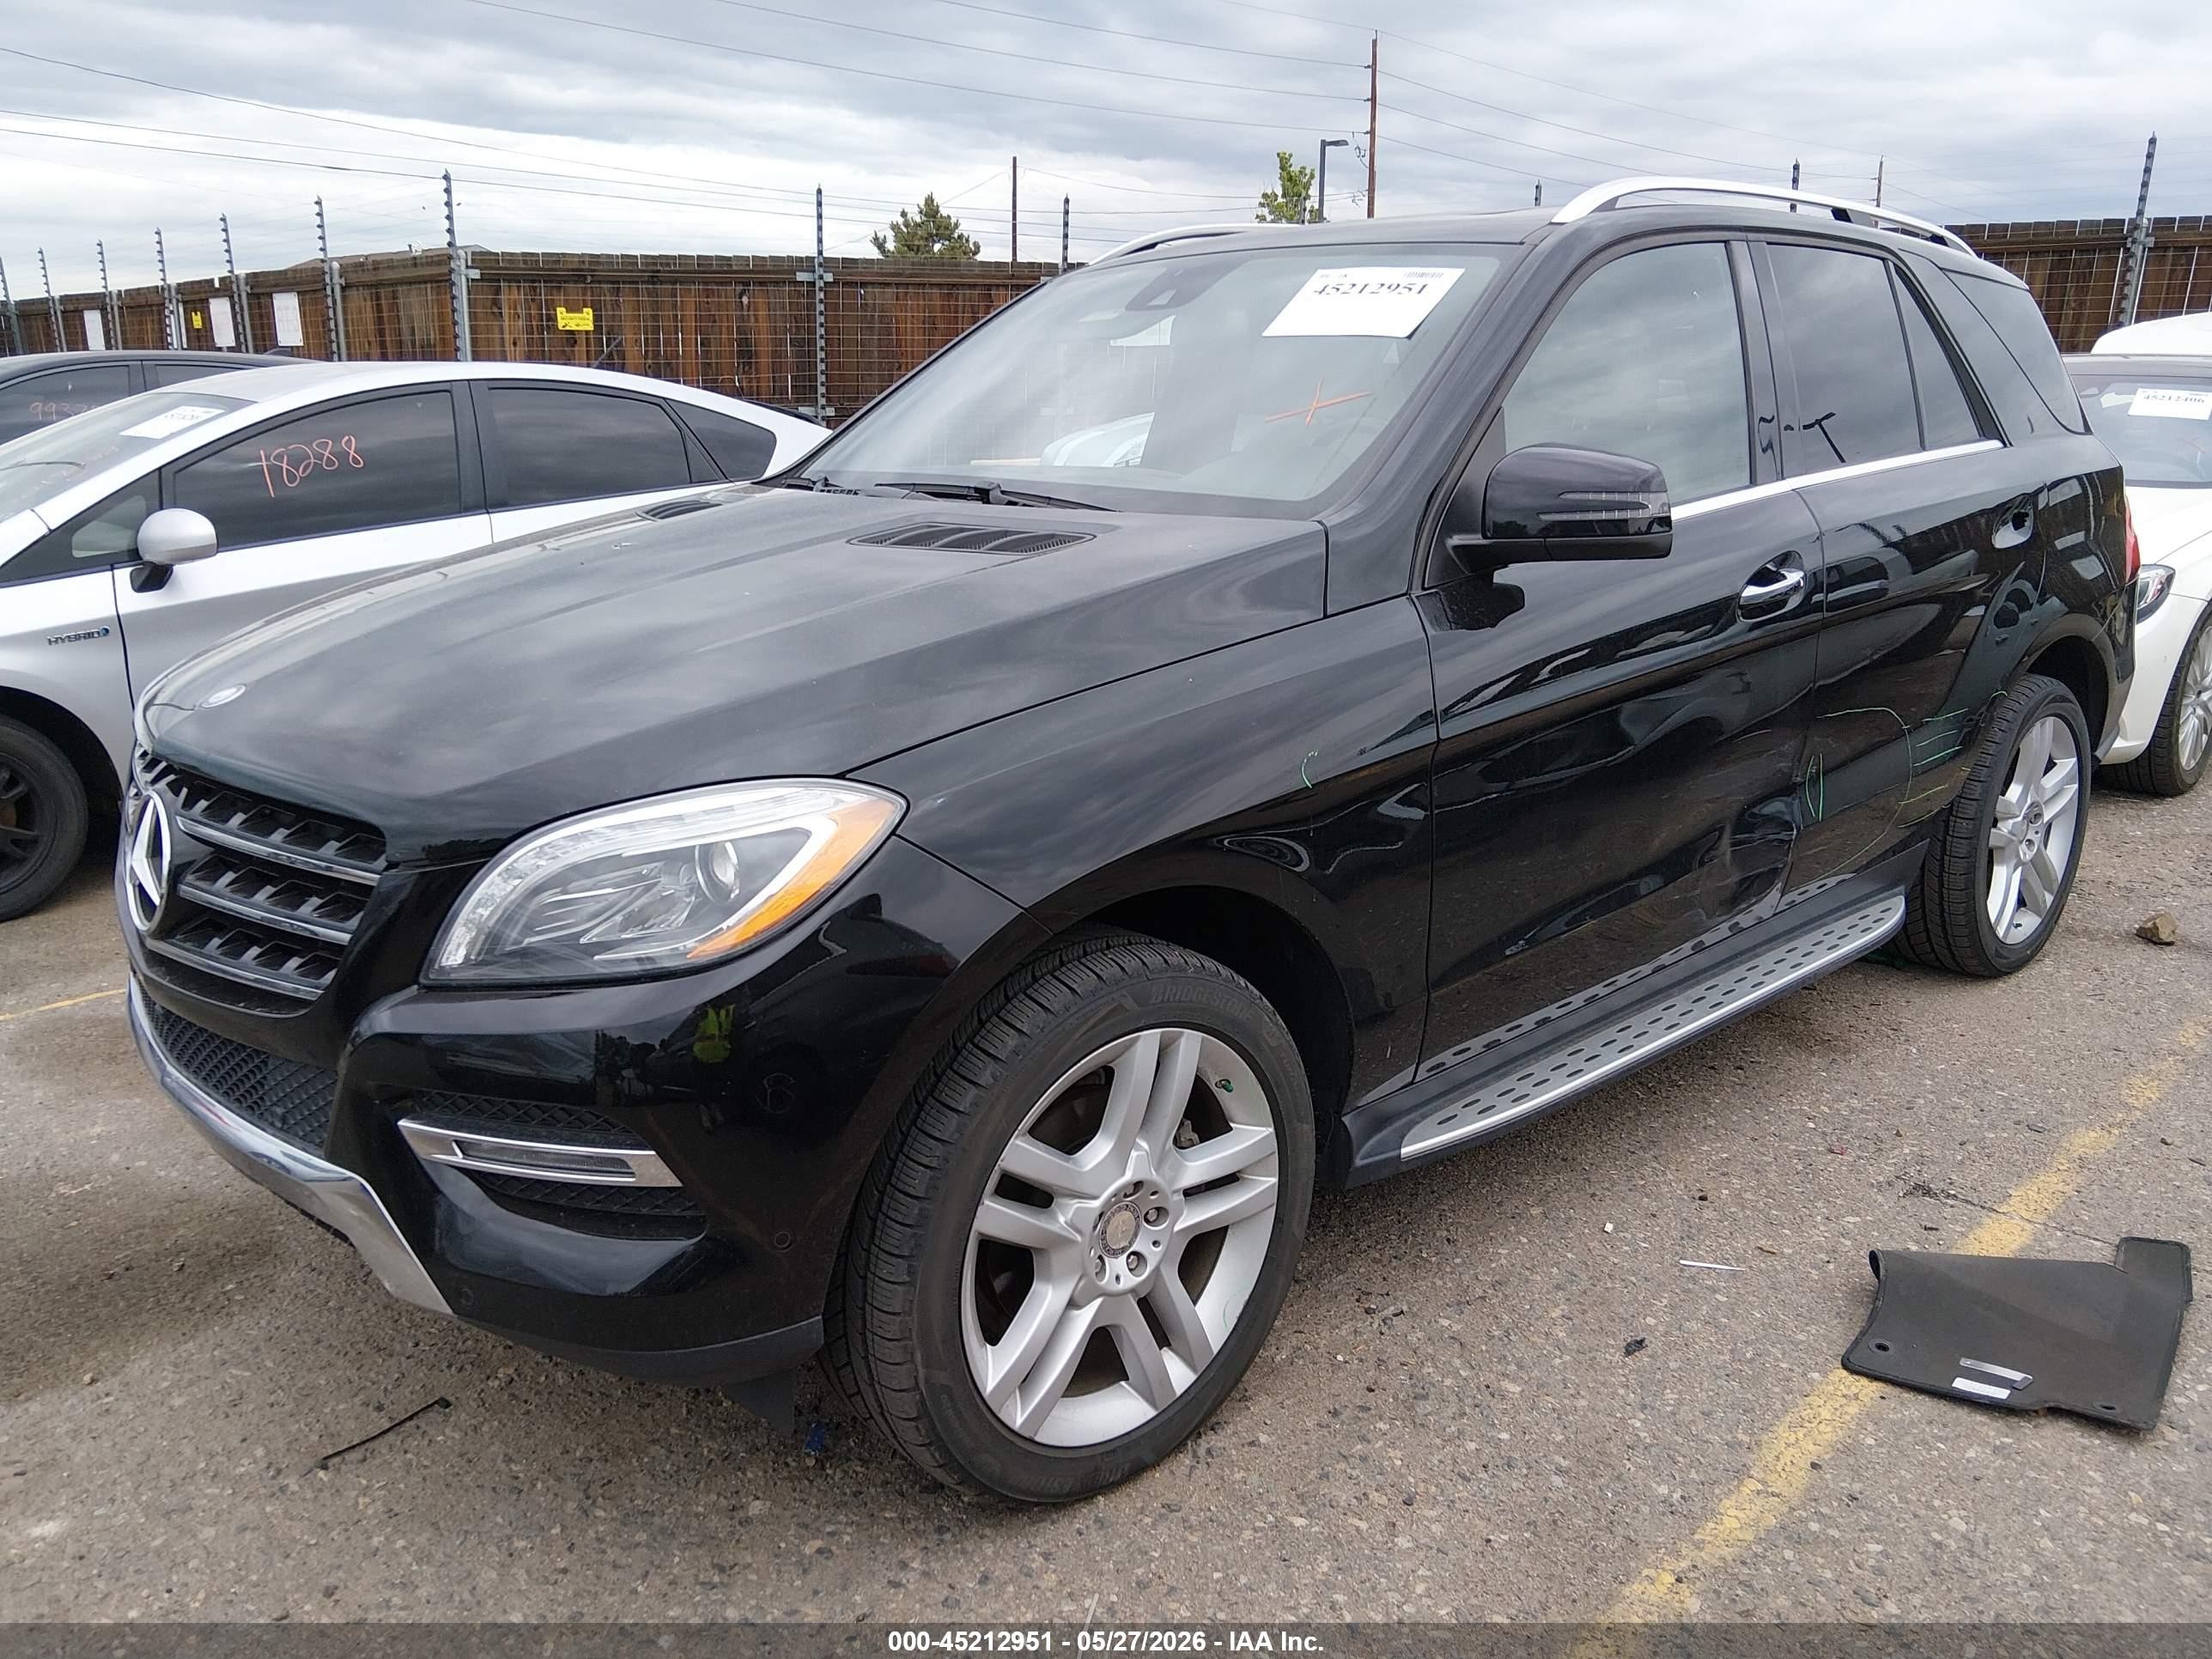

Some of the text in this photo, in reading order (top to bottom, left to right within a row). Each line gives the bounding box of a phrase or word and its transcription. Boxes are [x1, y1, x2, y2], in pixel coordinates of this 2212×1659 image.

[1313, 283, 1429, 295] 45212951
[259, 434, 365, 498] 18288
[46, 629, 100, 646] HYBRID
